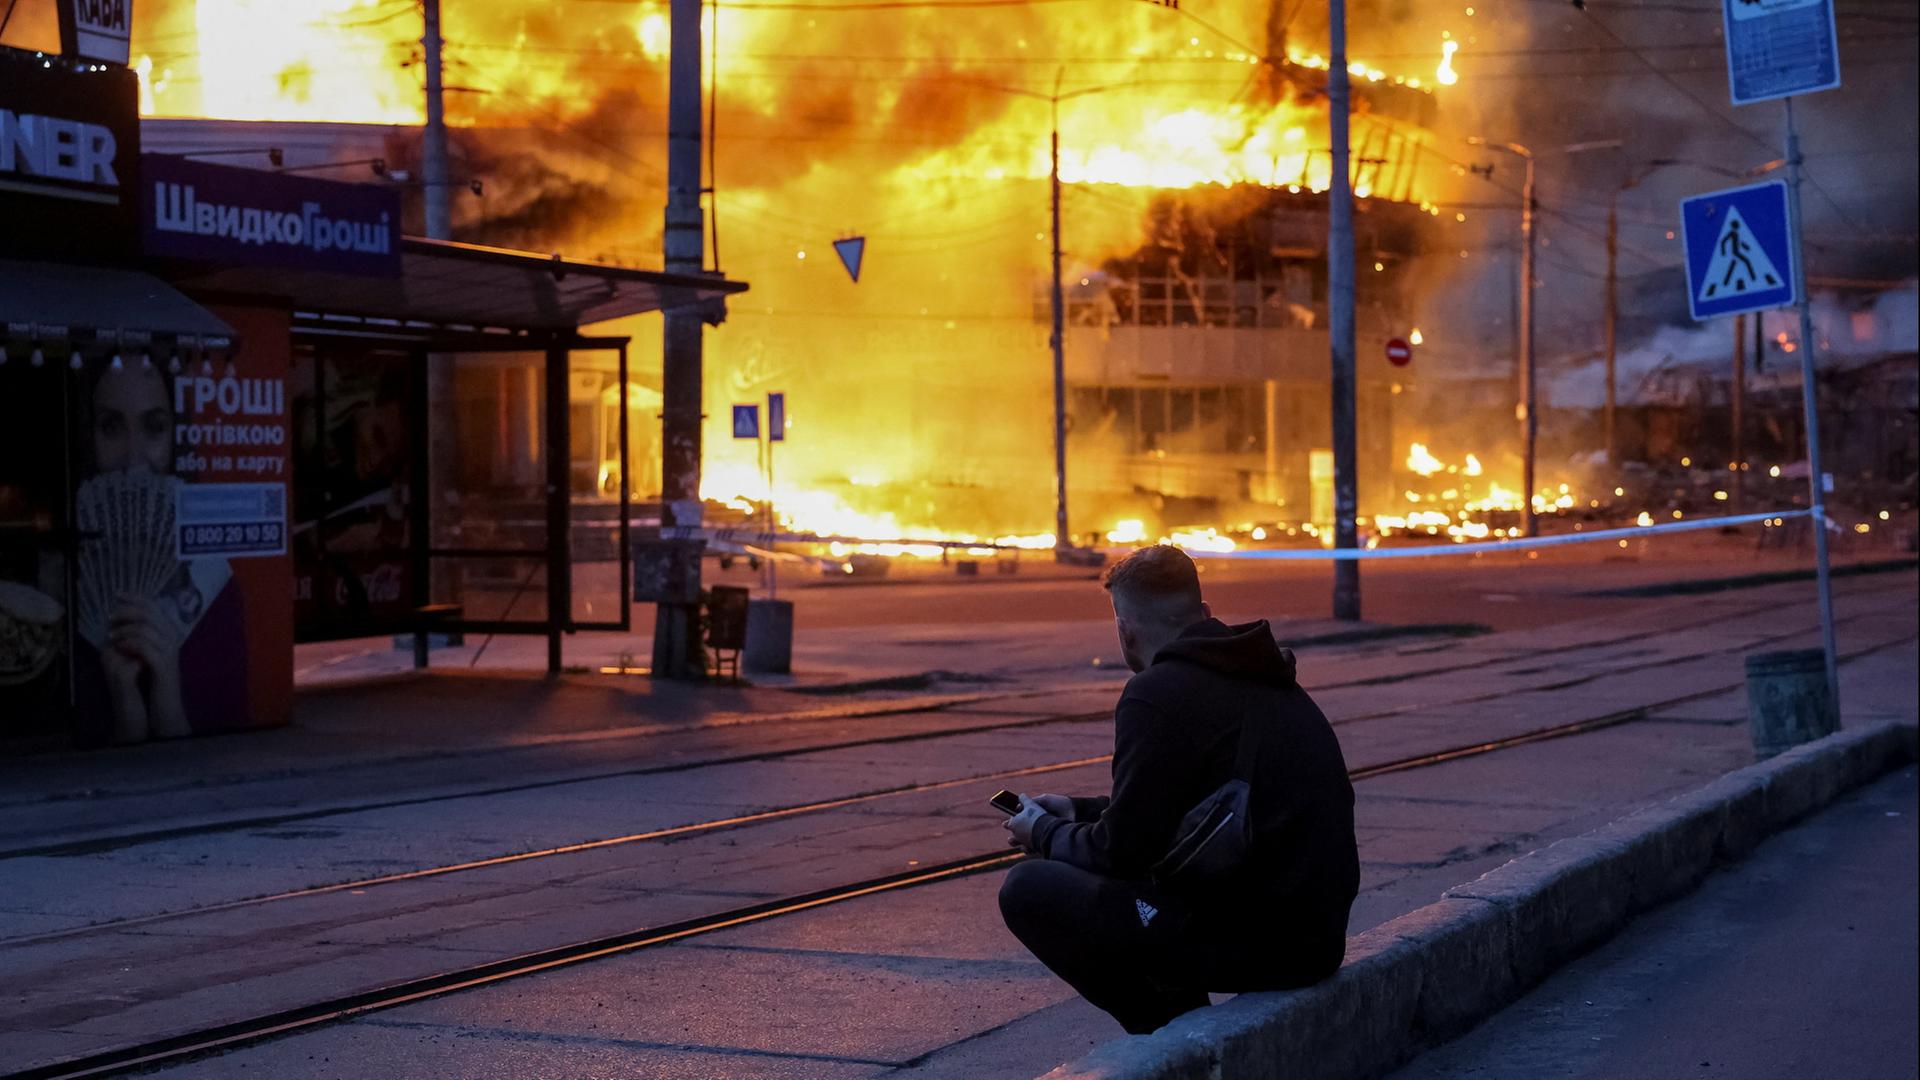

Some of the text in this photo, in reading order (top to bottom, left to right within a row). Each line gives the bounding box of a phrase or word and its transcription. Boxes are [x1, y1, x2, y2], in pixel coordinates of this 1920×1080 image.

[155, 181, 390, 255] ШвидкоГроші
[174, 376, 284, 415] ГРОШІ
[175, 419, 284, 446] готівкою
[176, 452, 285, 475] або на карту
[185, 524, 280, 545] 0 800 20 10 50
